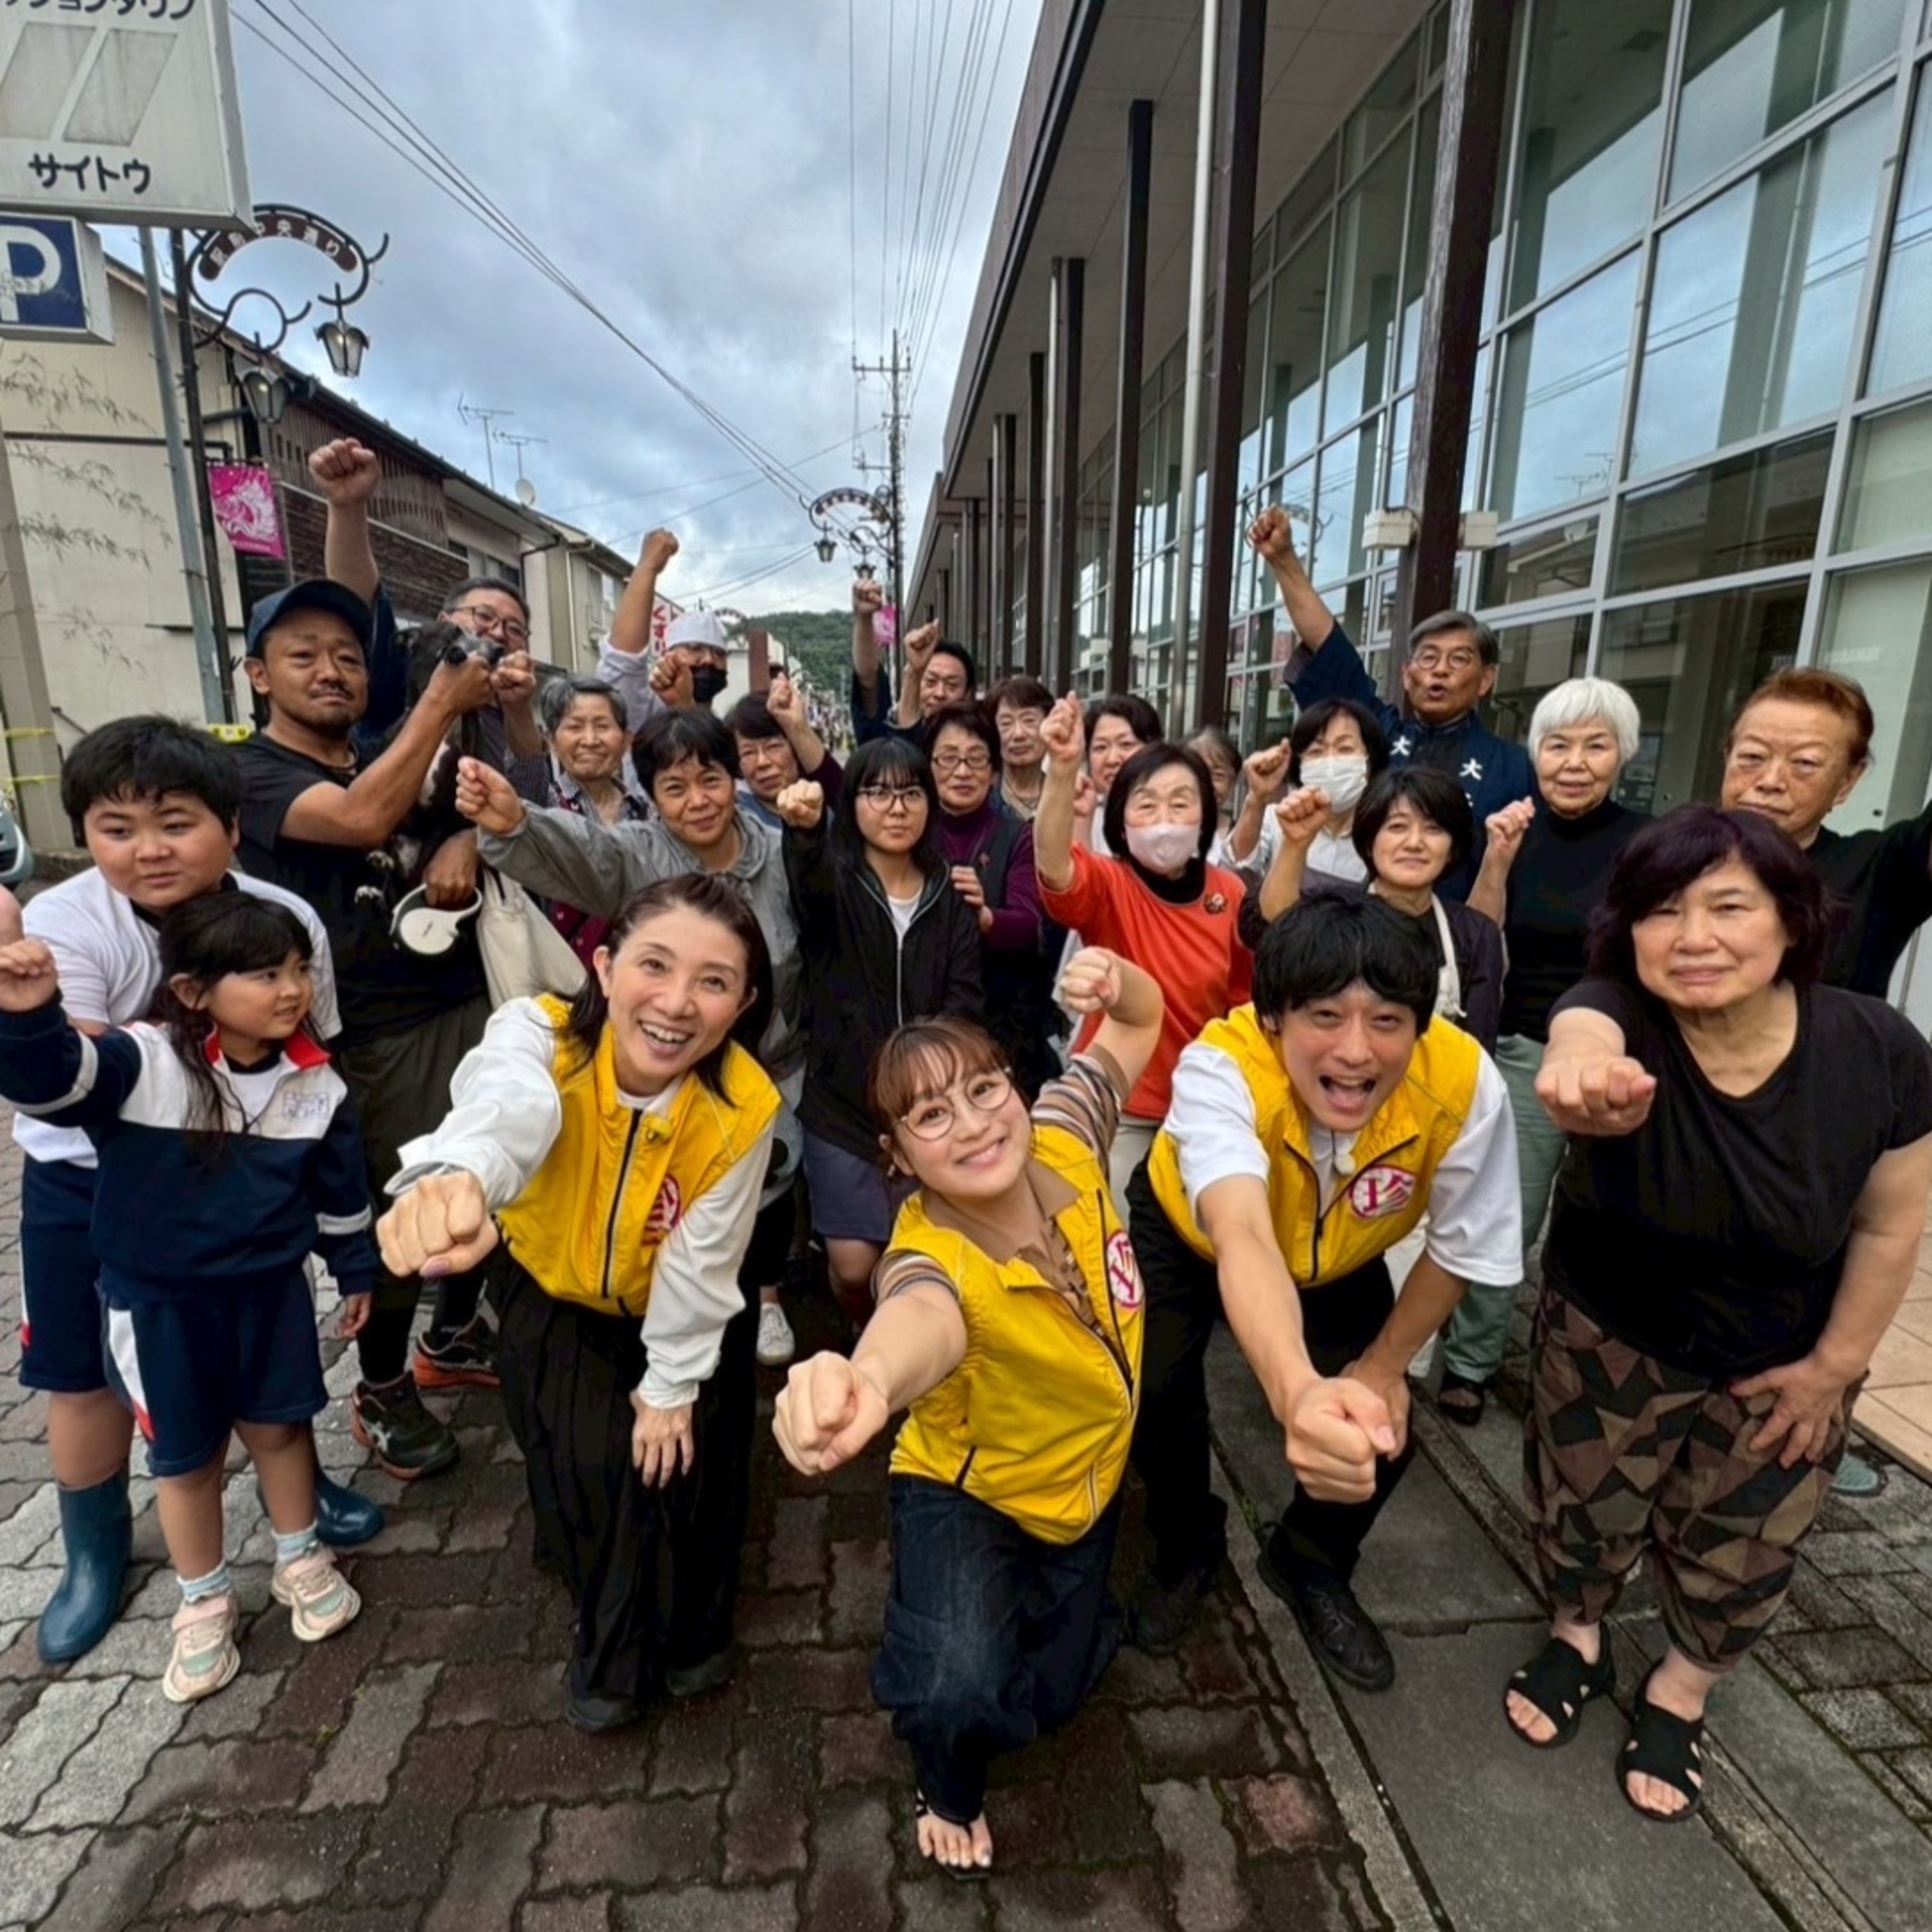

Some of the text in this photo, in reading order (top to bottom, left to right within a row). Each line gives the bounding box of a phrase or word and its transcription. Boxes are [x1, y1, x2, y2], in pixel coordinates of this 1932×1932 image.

[28, 153, 151, 194] サイトウ
[0, 225, 61, 322] P
[1389, 735, 1411, 756] 大
